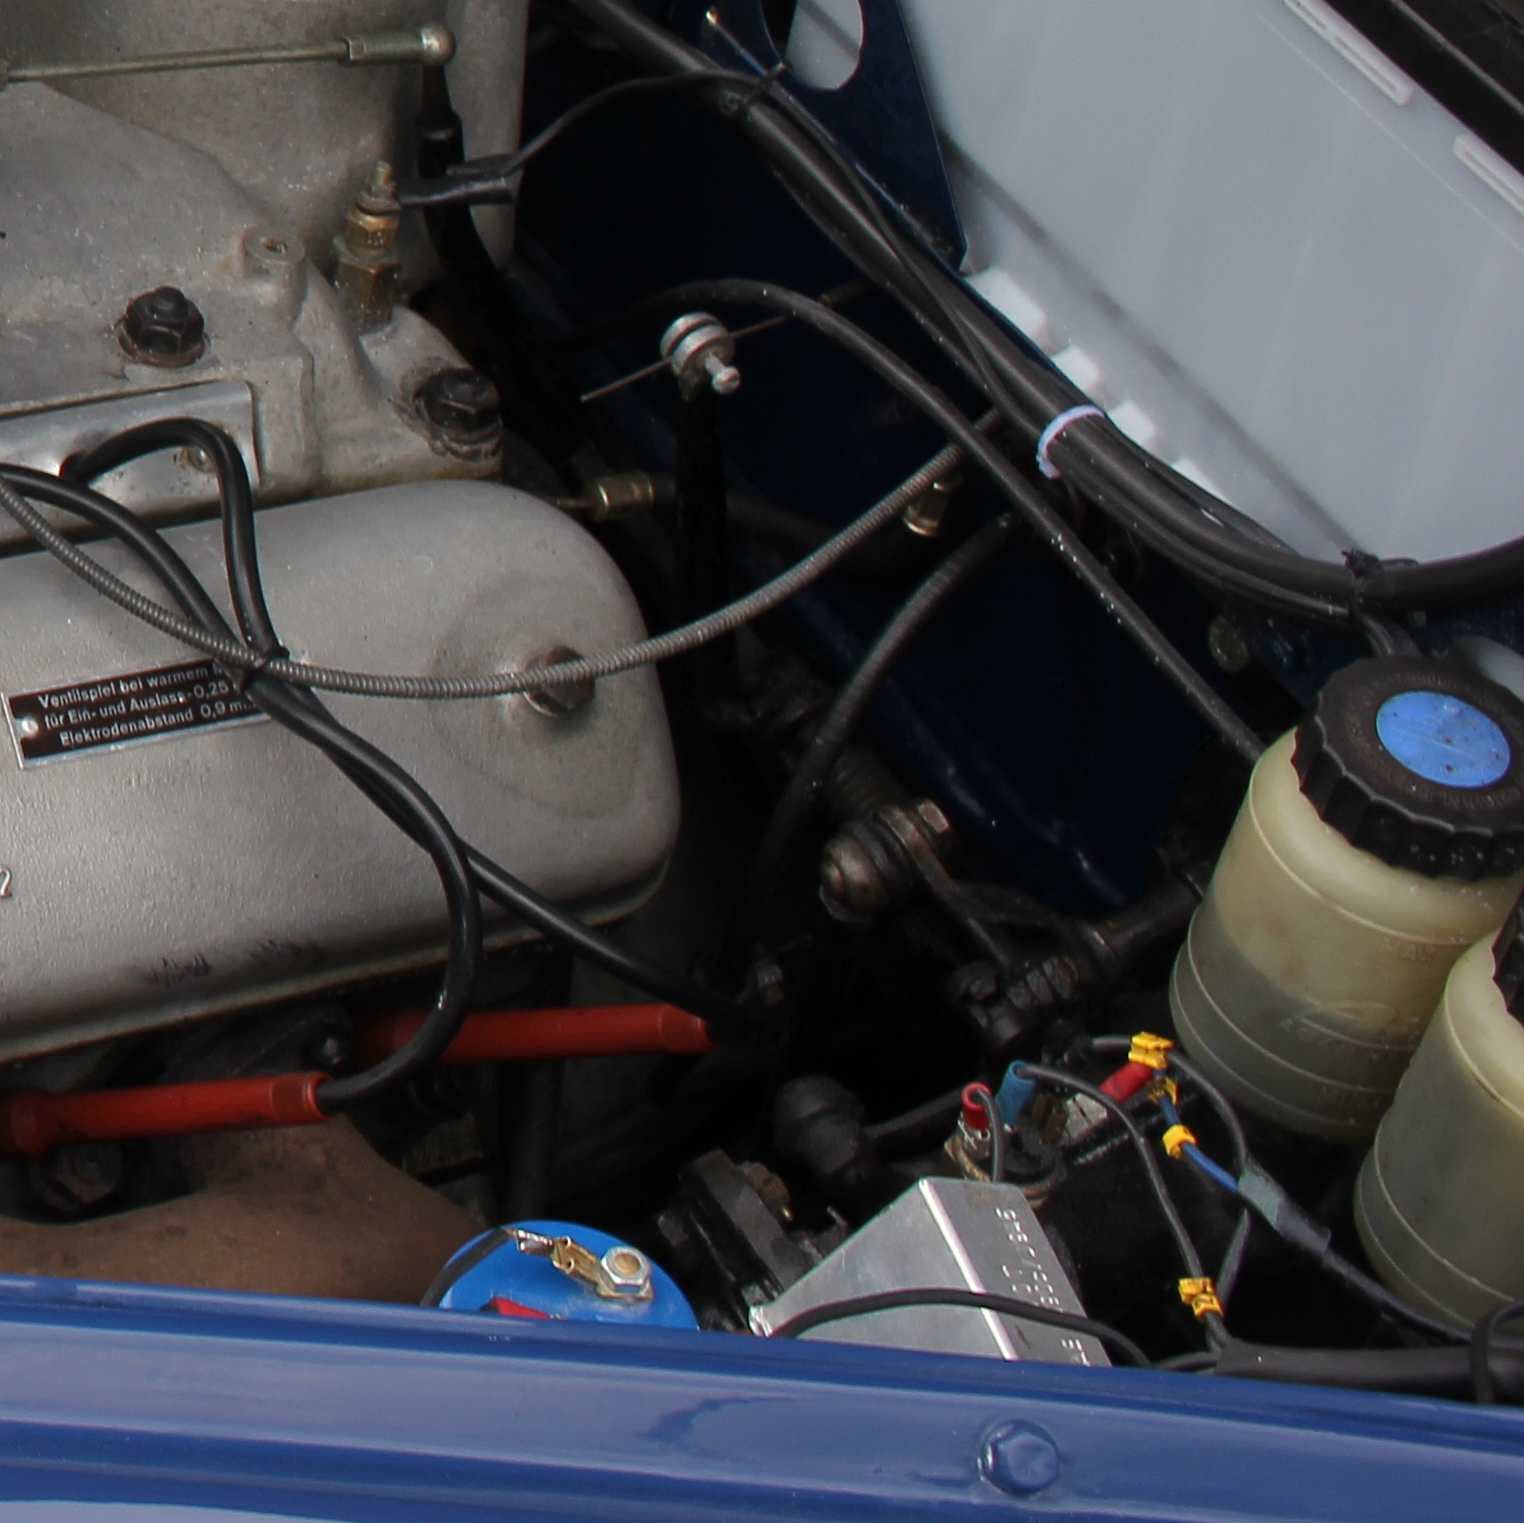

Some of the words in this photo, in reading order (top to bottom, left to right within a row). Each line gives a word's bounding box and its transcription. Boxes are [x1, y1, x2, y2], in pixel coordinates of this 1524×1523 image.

[37, 681, 117, 710] Ventilspiel
[120, 676, 144, 693] bei
[44, 714, 65, 731] für
[100, 700, 126, 718] und
[59, 707, 194, 747] Elektrodenabstand
